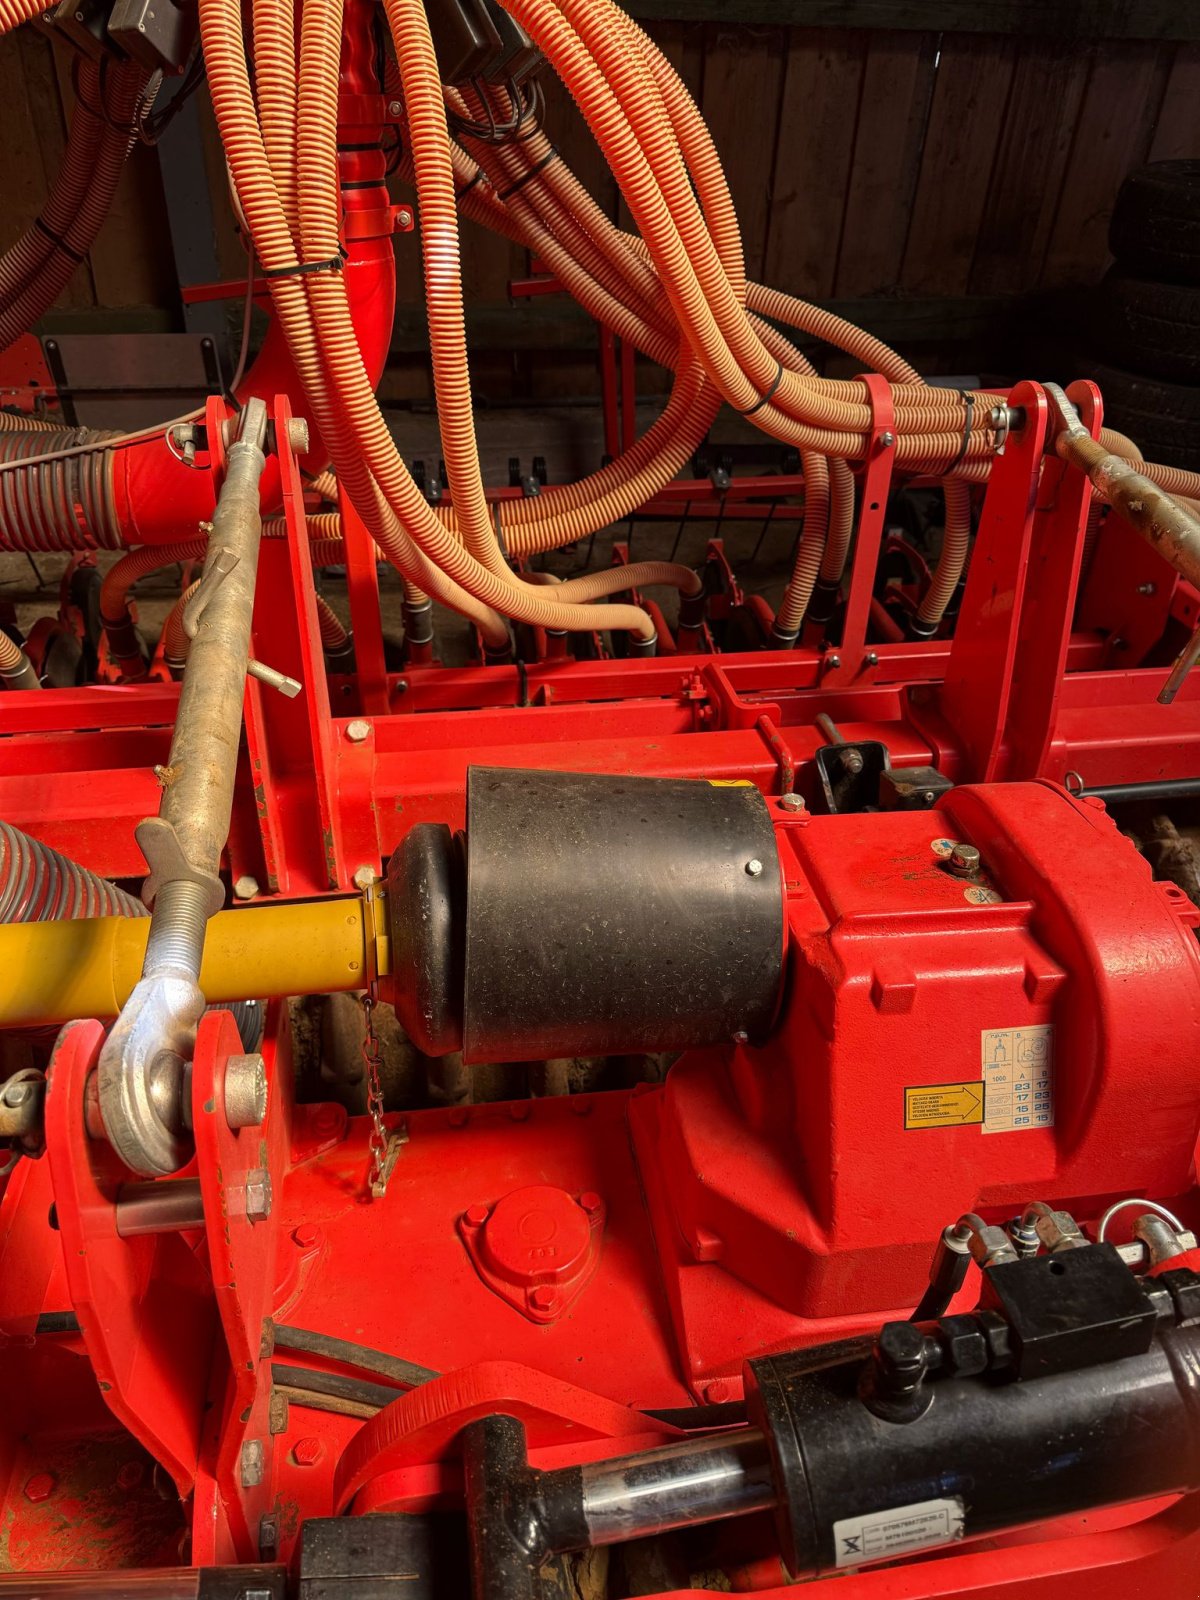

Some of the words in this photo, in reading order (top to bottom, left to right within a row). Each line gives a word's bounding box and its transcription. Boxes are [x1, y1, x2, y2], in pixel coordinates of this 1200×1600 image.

[1014, 1083, 1031, 1091] 23
[1034, 1091, 1050, 1099] 23
[1014, 1116, 1030, 1125] 25
